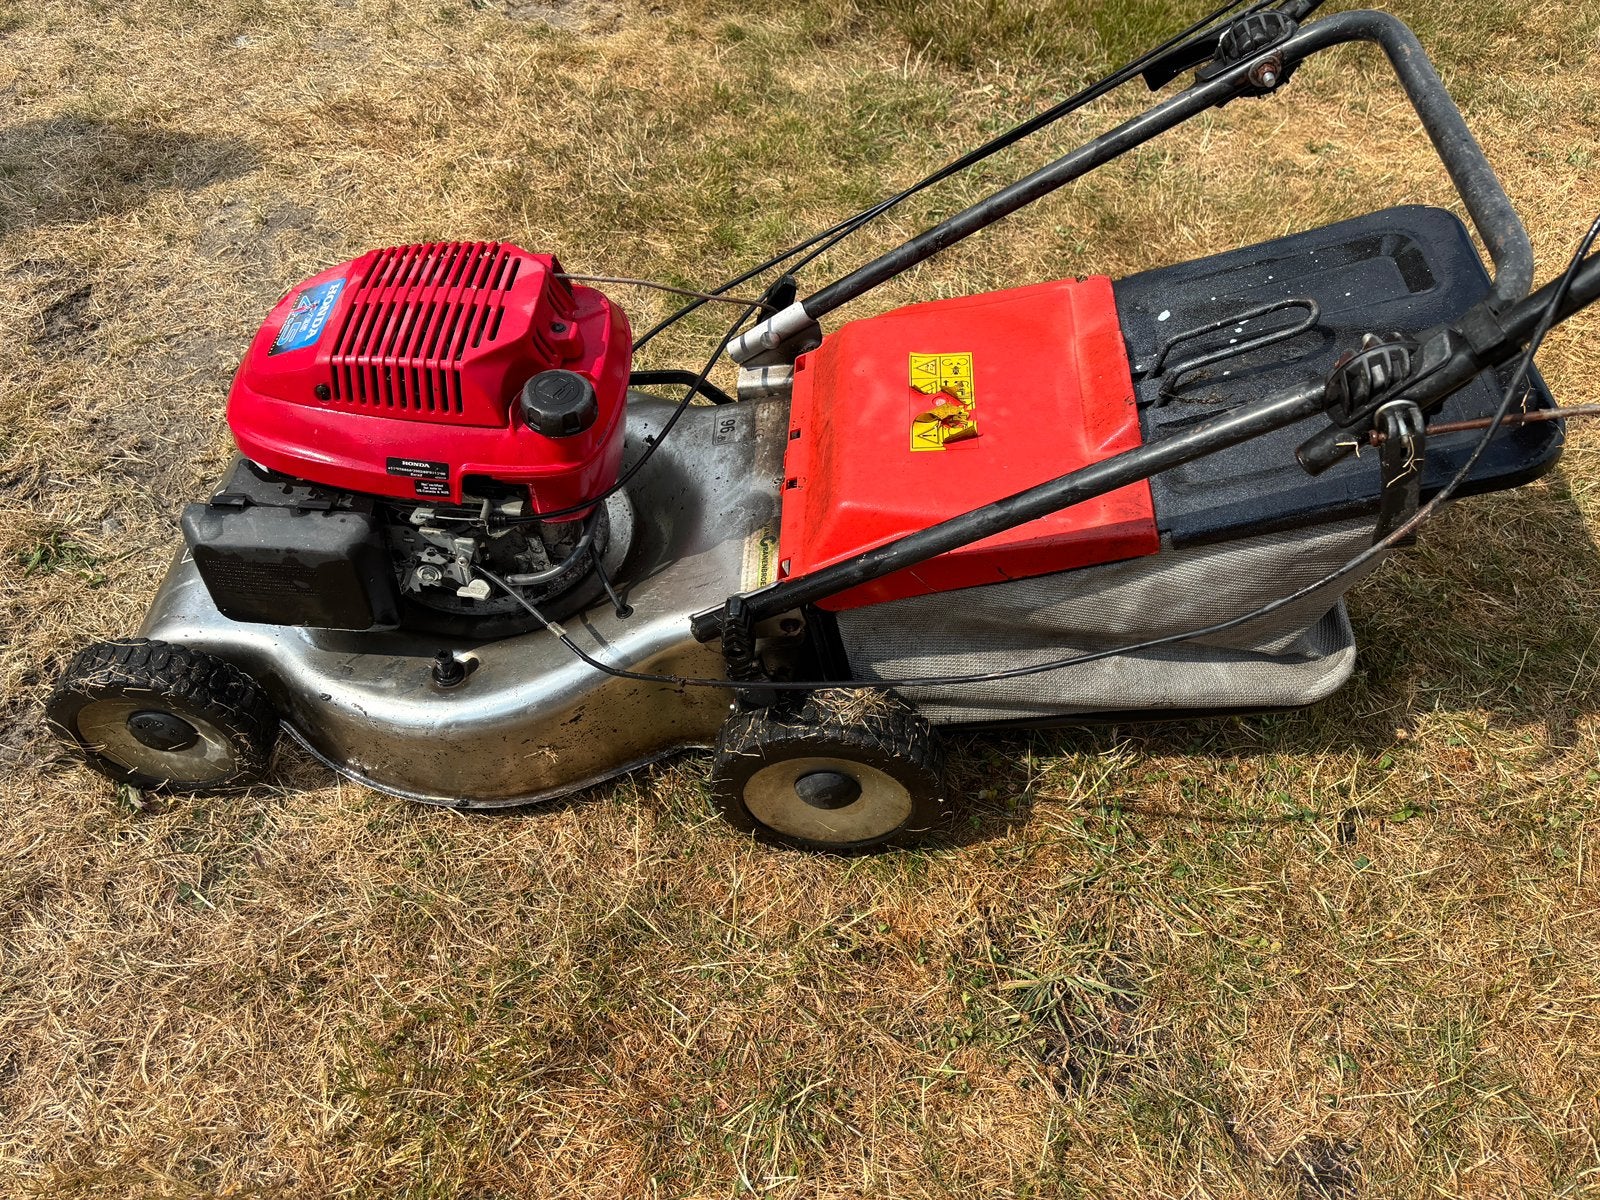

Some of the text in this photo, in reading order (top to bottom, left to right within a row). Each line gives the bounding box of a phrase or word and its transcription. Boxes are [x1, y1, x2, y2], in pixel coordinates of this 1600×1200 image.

[304, 283, 341, 341] HONDA
[720, 420, 736, 433] 96
[401, 460, 430, 468] HONDA
